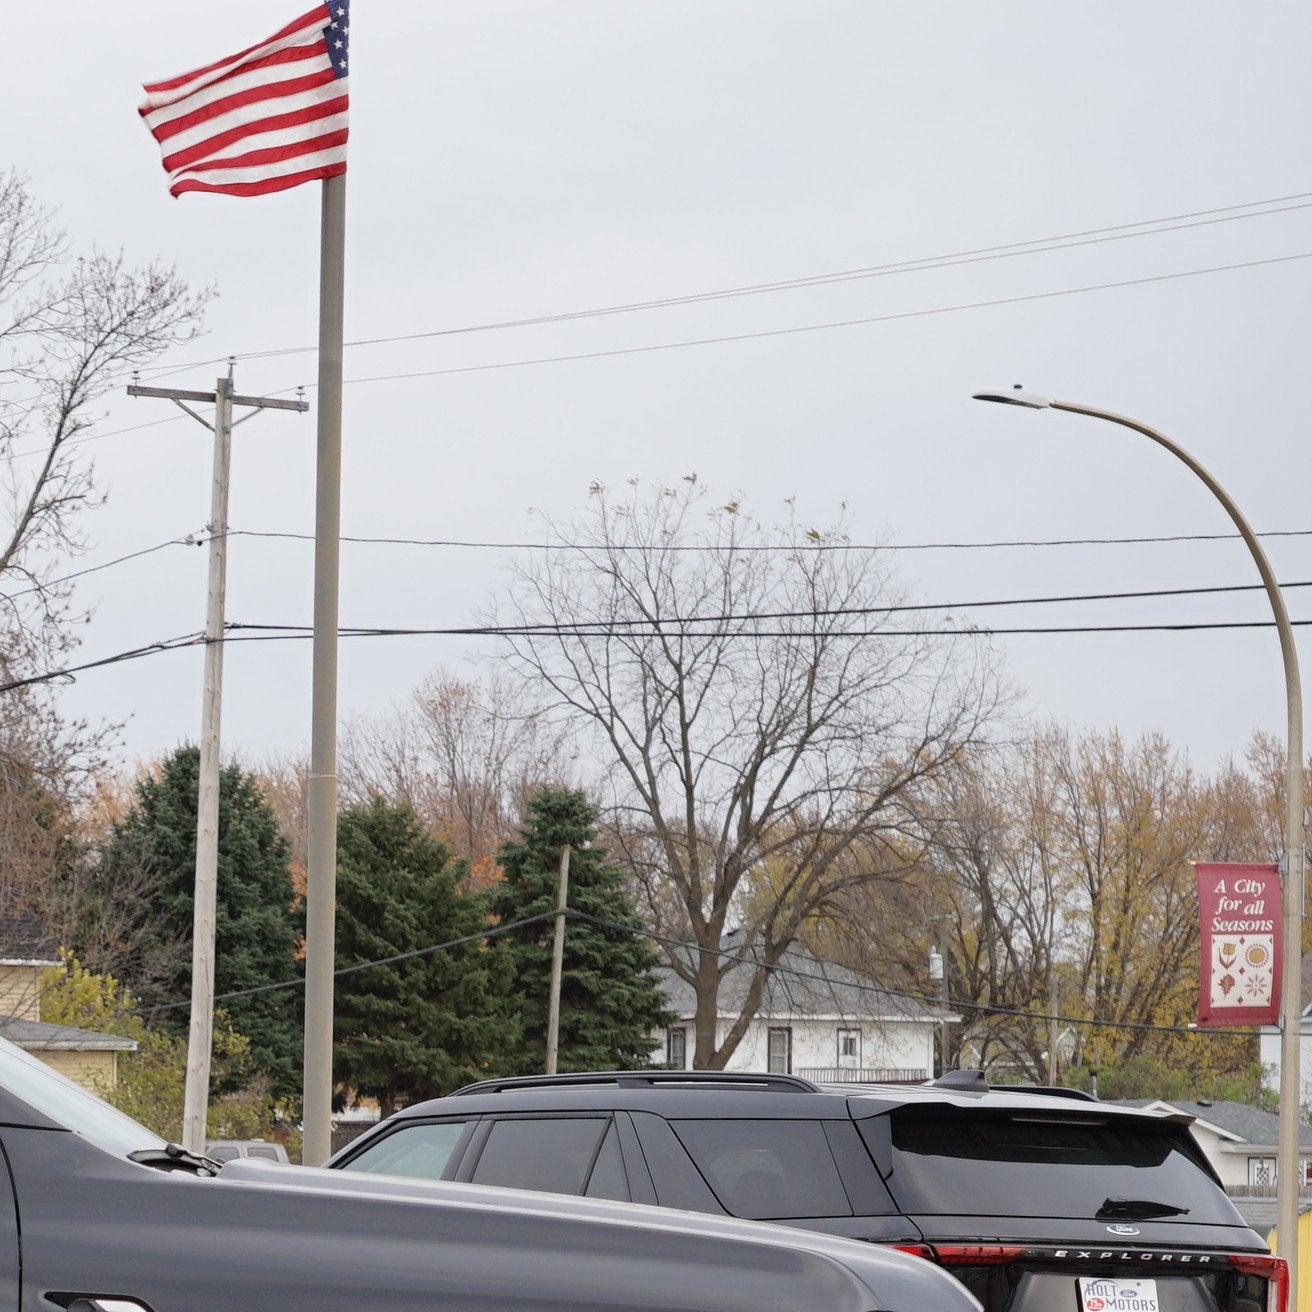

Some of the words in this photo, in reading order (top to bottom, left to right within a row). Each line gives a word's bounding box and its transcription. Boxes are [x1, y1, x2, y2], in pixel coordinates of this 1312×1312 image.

[1214, 879, 1226, 893] A
[1234, 879, 1266, 897] City
[1215, 896, 1242, 915] for
[1244, 900, 1265, 915] all
[1212, 917, 1273, 932] Seasons
[1054, 1250, 1210, 1263] EXPLORER
[1087, 1283, 1117, 1297] HOLT
[1106, 1297, 1156, 1311] MOTORS
